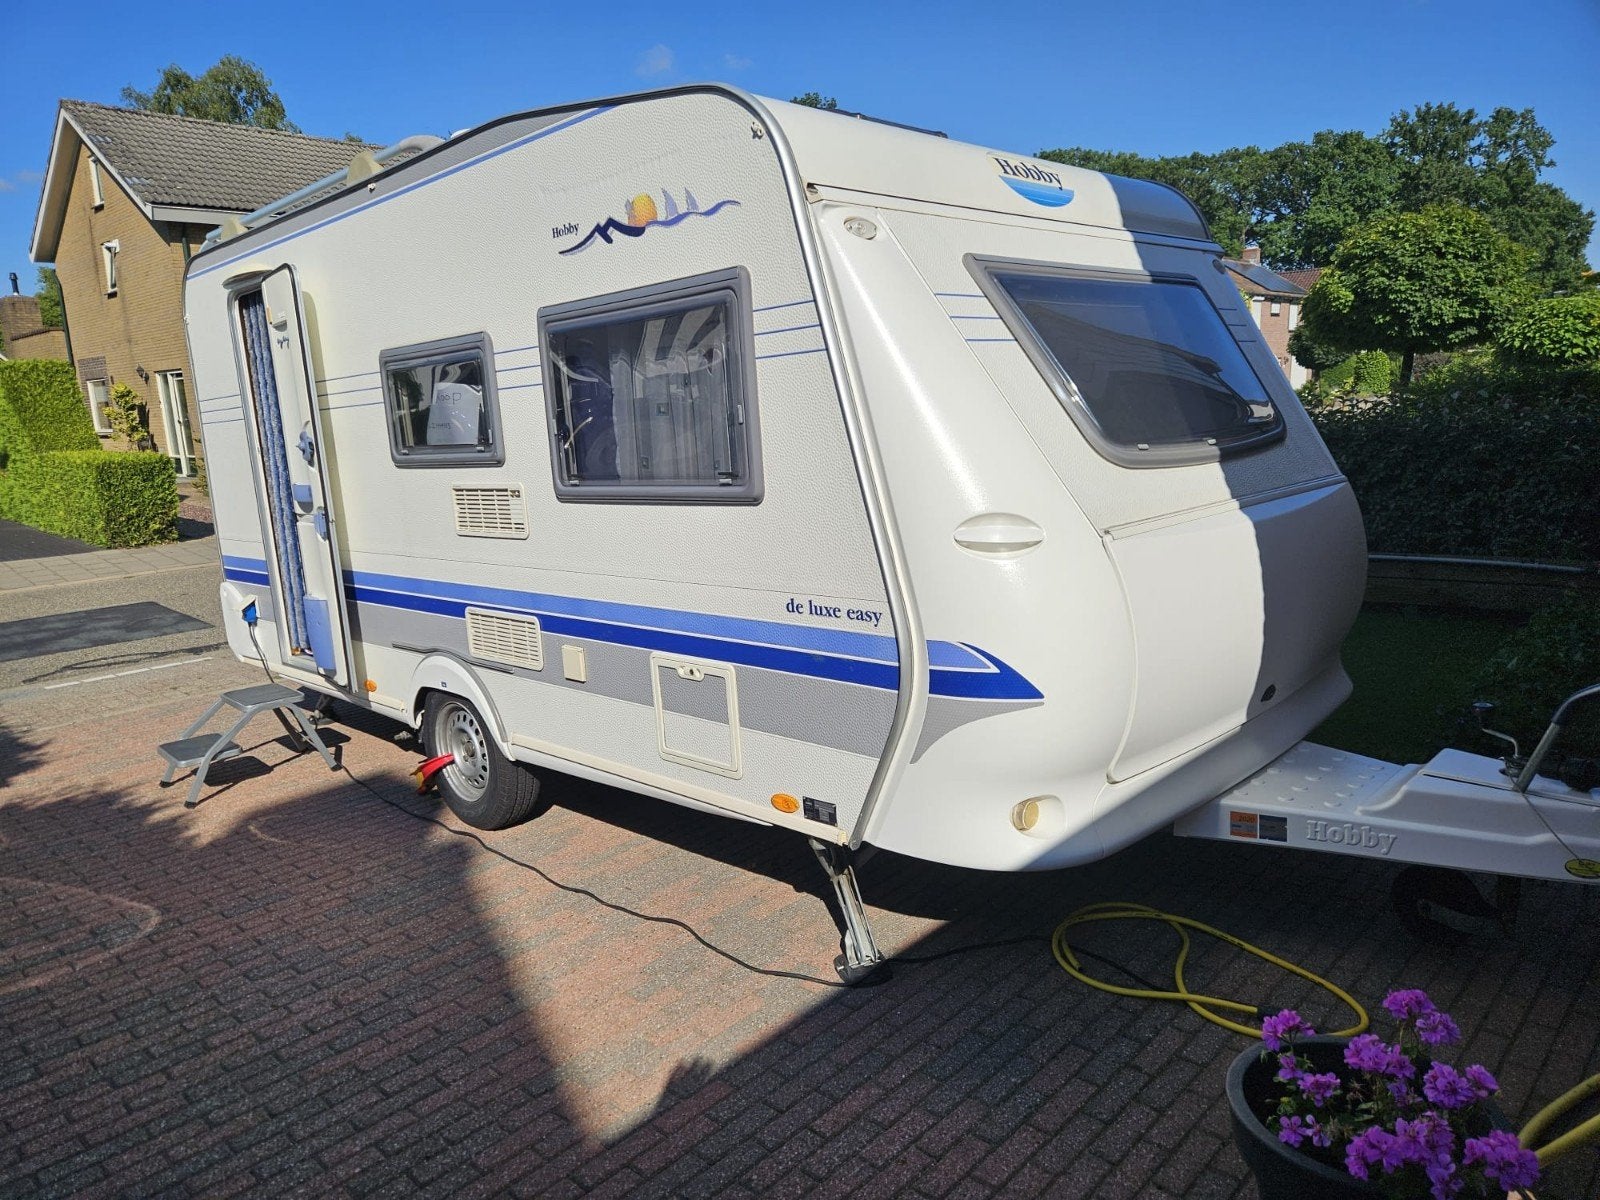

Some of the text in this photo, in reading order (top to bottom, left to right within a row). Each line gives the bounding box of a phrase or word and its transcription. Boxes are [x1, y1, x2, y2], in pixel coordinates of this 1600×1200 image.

[993, 157, 1064, 191] Hobby
[551, 221, 580, 239] Hobby
[786, 598, 883, 627] de luxe easy
[1306, 819, 1398, 855] Hobby
